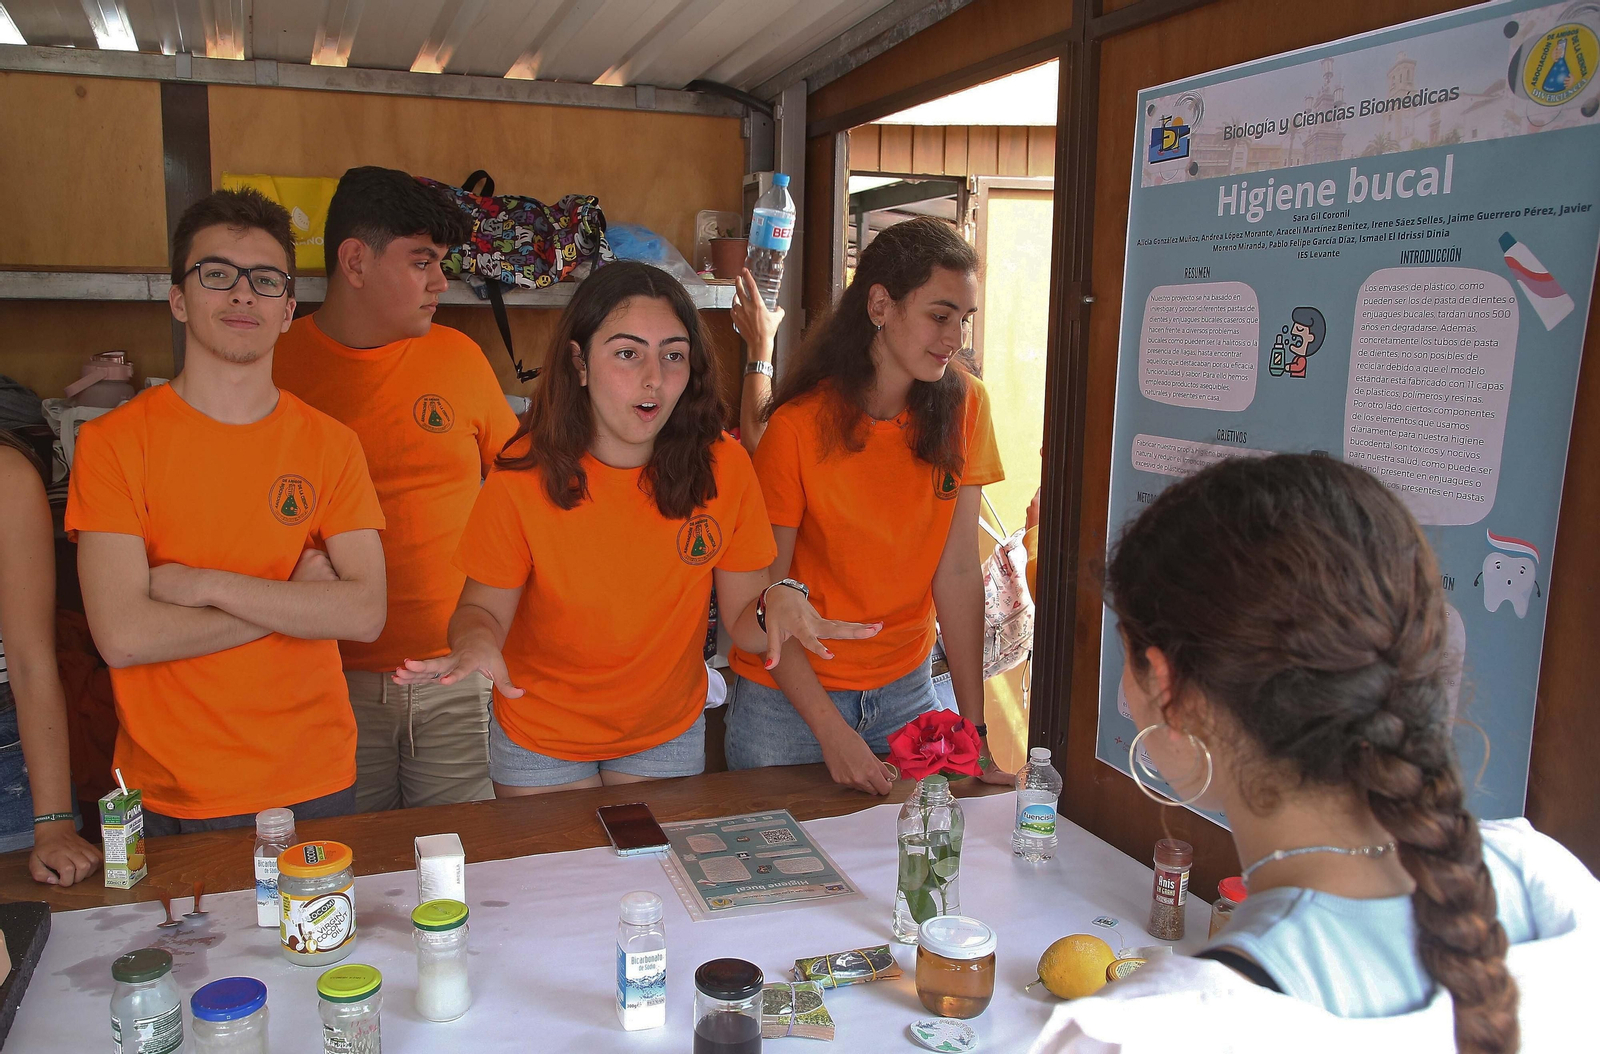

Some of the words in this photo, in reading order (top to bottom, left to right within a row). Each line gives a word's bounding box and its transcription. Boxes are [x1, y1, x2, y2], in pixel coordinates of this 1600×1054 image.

[1572, 35, 1579, 45] DE
[1574, 45, 1581, 53] LA
[1531, 42, 1552, 86] ASOCIACIÓN
[1577, 52, 1587, 77] CIENCIA
[1224, 117, 1275, 141] Biología
[1279, 117, 1289, 135] y
[1293, 105, 1354, 128] Ciencias
[1359, 86, 1460, 116] Biomédicas
[1218, 178, 1336, 223] Higiene
[1347, 154, 1454, 204] bucal
[1293, 214, 1308, 222] Sara
[1310, 212, 1321, 220] Gil
[1323, 210, 1350, 219] Coronil
[1137, 238, 1152, 246] Alicia
[1153, 236, 1178, 245] González
[1179, 235, 1200, 243] Muñoz,
[1201, 233, 1223, 241] Andrea
[1224, 231, 1243, 241] López
[1245, 229, 1275, 238] Morante,
[1276, 227, 1300, 236] Araceli
[1303, 224, 1336, 234] Martínez
[1371, 219, 1393, 229] Irene
[1395, 216, 1415, 227] Sáez
[1417, 215, 1445, 226] Selles,
[1447, 213, 1474, 225] Jaime
[1477, 209, 1521, 221] Guerrero
[1523, 206, 1557, 217] Pérez,
[1558, 203, 1592, 217] Javier
[1213, 244, 1236, 252] Moreno
[1238, 242, 1267, 250] Miranda,
[1269, 240, 1288, 248] Pablo
[1290, 238, 1310, 249] Felipe
[1313, 237, 1337, 246] García
[1338, 235, 1356, 244] Díaz,
[1359, 232, 1387, 242] Ismael
[1388, 231, 1396, 241] El
[1397, 230, 1425, 240] Idrissi
[1427, 229, 1450, 239] Dinia
[1310, 250, 1340, 259] Levante
[1400, 245, 1462, 264] INTRODUCCIÓN
[1184, 267, 1211, 279] RESUMEN
[1365, 284, 1377, 292] Los
[1411, 283, 1421, 291] de
[1363, 298, 1393, 306] pueden
[1408, 296, 1419, 304] los
[1422, 296, 1432, 304] de
[1459, 296, 1469, 304] de
[1472, 295, 1506, 304] dientes
[1362, 310, 1401, 319] enjuagues
[1437, 310, 1465, 318] tardan
[1492, 310, 1511, 318] 500
[1361, 323, 1378, 331] años
[1360, 337, 1418, 345] concretamente
[1420, 337, 1432, 345] los
[1434, 338, 1458, 346] tubos
[1460, 338, 1471, 347] de
[1474, 339, 1498, 348] pasta
[1358, 349, 1368, 357] de
[1430, 350, 1464, 360] posibles
[1467, 352, 1478, 361] de
[1357, 362, 1384, 370] reciclar
[1386, 362, 1414, 372] debido
[1422, 365, 1438, 374] que
[1441, 364, 1448, 373] el
[1450, 365, 1485, 375] modelo
[1408, 377, 1446, 387] fabricado
[1449, 380, 1465, 388] con
[1467, 380, 1474, 388] 11
[1476, 382, 1504, 391] capas
[1354, 387, 1364, 395] de
[1402, 390, 1442, 400] polímeros
[1444, 394, 1449, 402] y
[1353, 400, 1366, 408] Por
[1368, 402, 1383, 410] otro
[1405, 404, 1432, 413] ciertos
[1433, 407, 1495, 419] componentes
[1352, 412, 1362, 420] de
[1364, 413, 1374, 421] los
[1376, 414, 1416, 425] elementos
[1418, 419, 1434, 428] que
[1436, 420, 1469, 430] usamos
[1217, 429, 1247, 443] OBJETIVOS
[1351, 425, 1396, 436] diariamente
[1398, 431, 1415, 439] para
[1418, 433, 1448, 442] nuestra
[1451, 435, 1484, 446] higiene
[127, 805, 141, 819] PIÑA
[768, 880, 809, 888] Higiene
[1159, 876, 1174, 889] Anis
[317, 912, 343, 934] VIRGIN
[317, 912, 348, 942] COCONUT
[332, 928, 343, 939] OIL
[631, 953, 662, 964] Bicarbonato
